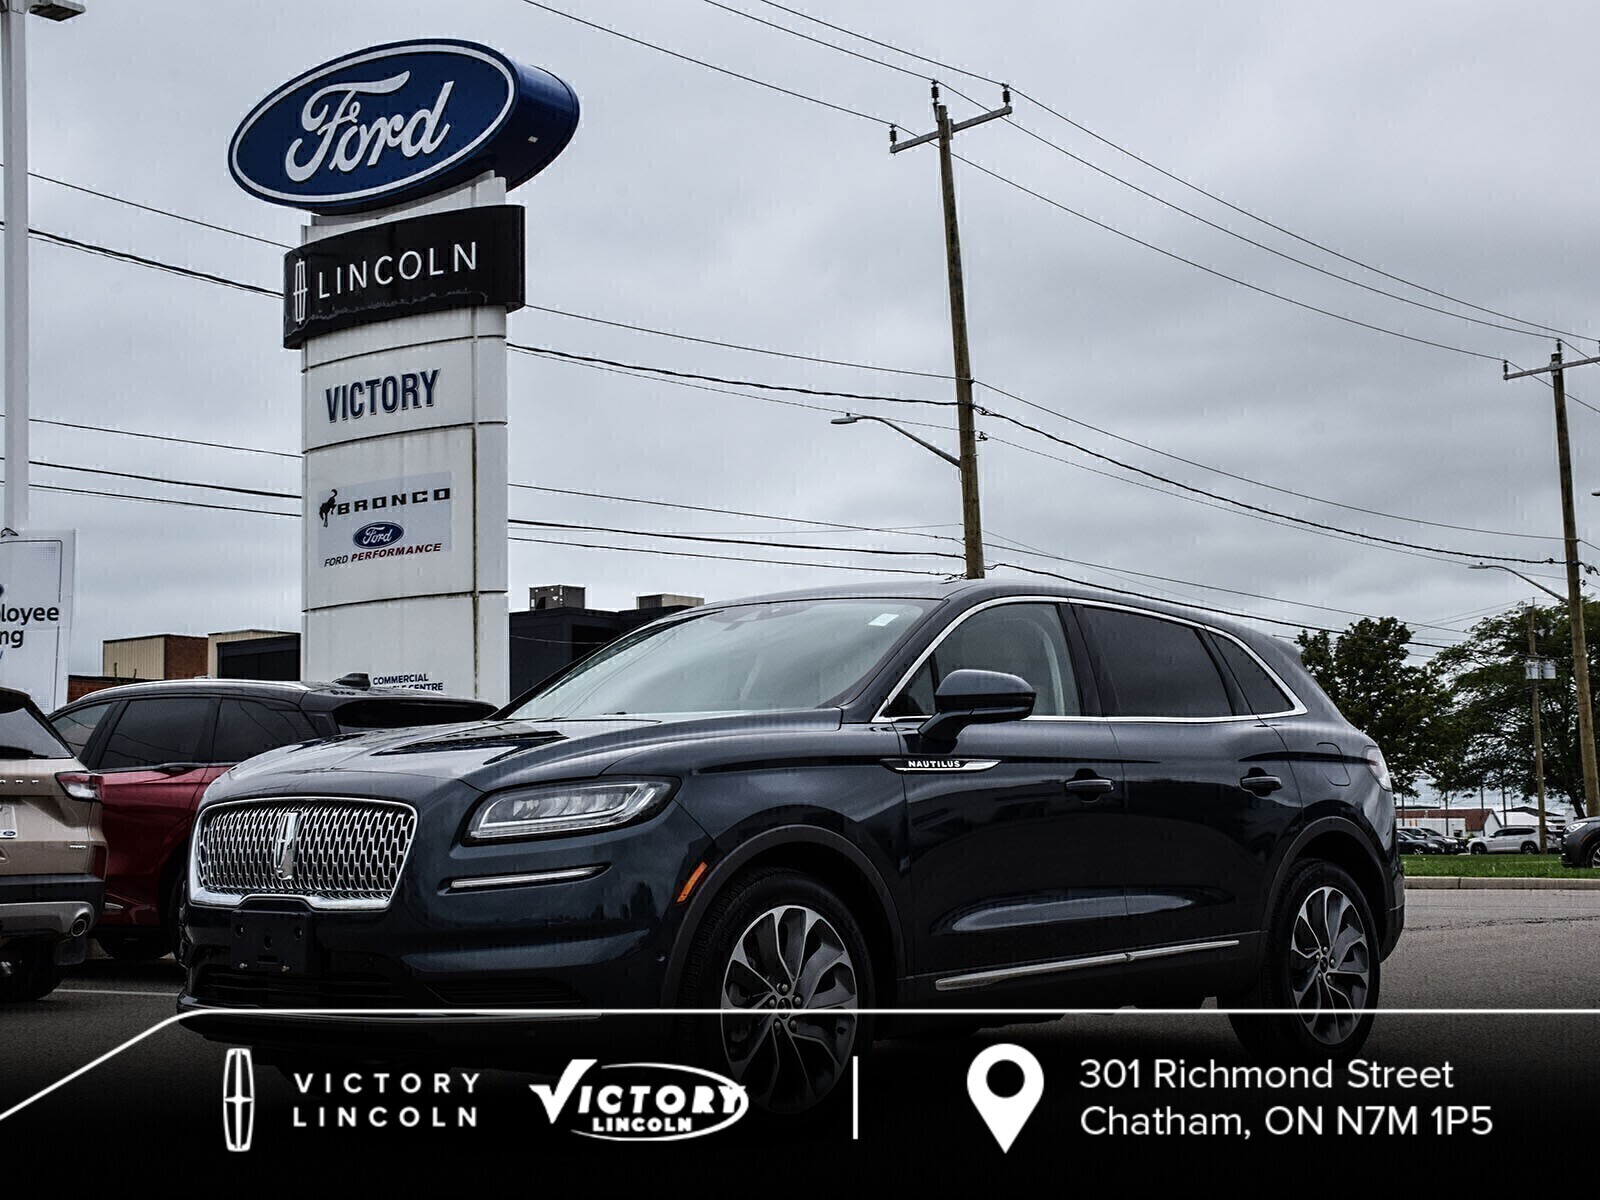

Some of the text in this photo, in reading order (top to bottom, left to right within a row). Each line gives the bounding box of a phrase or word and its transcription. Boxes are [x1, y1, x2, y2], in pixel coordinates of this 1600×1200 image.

[285, 70, 455, 182] Ford
[319, 241, 476, 299] LINCOLN
[325, 368, 441, 423] VICTORY
[337, 487, 450, 515] BRONCO
[362, 526, 393, 545] Ford
[324, 543, 442, 567] FORD PERFORMANCE
[0, 603, 59, 626] loyee
[373, 673, 430, 685] COMMERCIAL
[908, 760, 960, 768] NAUTILUS
